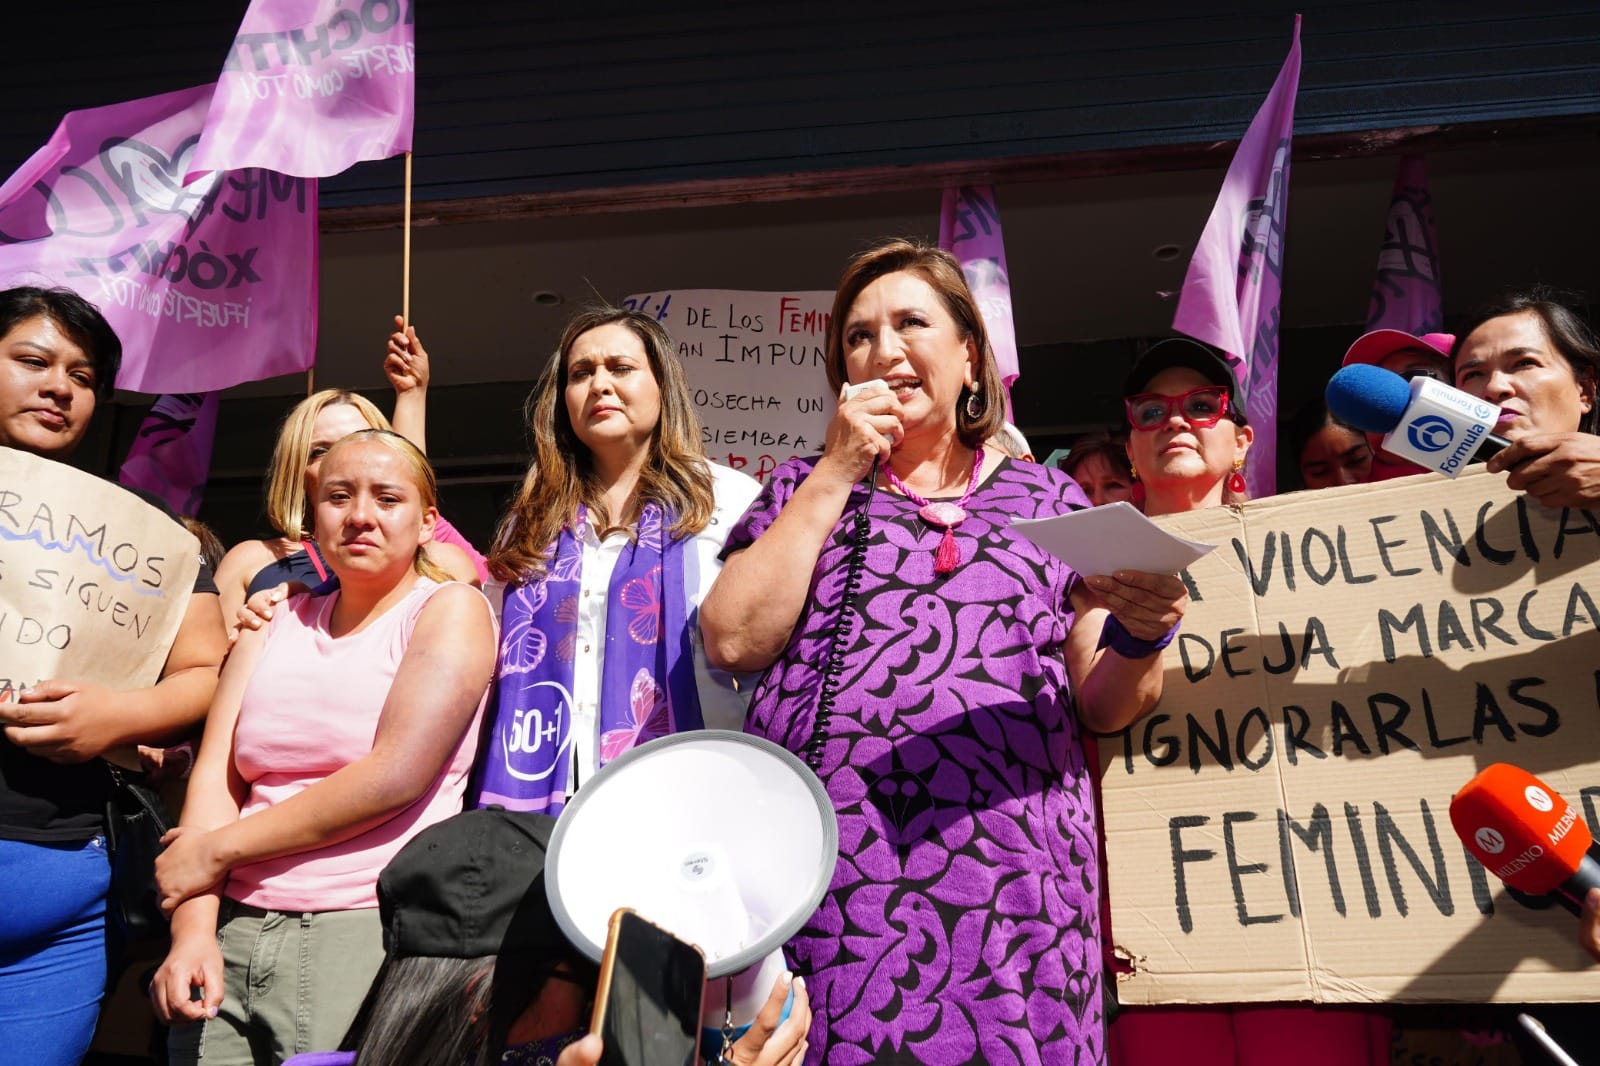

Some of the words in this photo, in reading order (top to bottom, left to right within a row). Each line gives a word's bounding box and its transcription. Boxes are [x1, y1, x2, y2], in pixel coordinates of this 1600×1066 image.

[687, 306, 717, 329] DE
[679, 342, 703, 358] AN
[715, 334, 826, 367] IMPUN
[689, 389, 781, 412] OSECHA
[797, 396, 823, 413] UN
[702, 427, 808, 449] SIEMBRA
[1439, 423, 1486, 474] Fórmula
[0, 490, 164, 588] RAMOS
[1231, 495, 1600, 597] VIOLENCIA
[28, 568, 151, 640] SIGUEN
[0, 613, 71, 650] DO
[1178, 616, 1340, 683] DEJA
[508, 701, 563, 754] 50+1
[1123, 676, 1560, 775] IGNORARLAS
[1495, 844, 1544, 879] MILENIO
